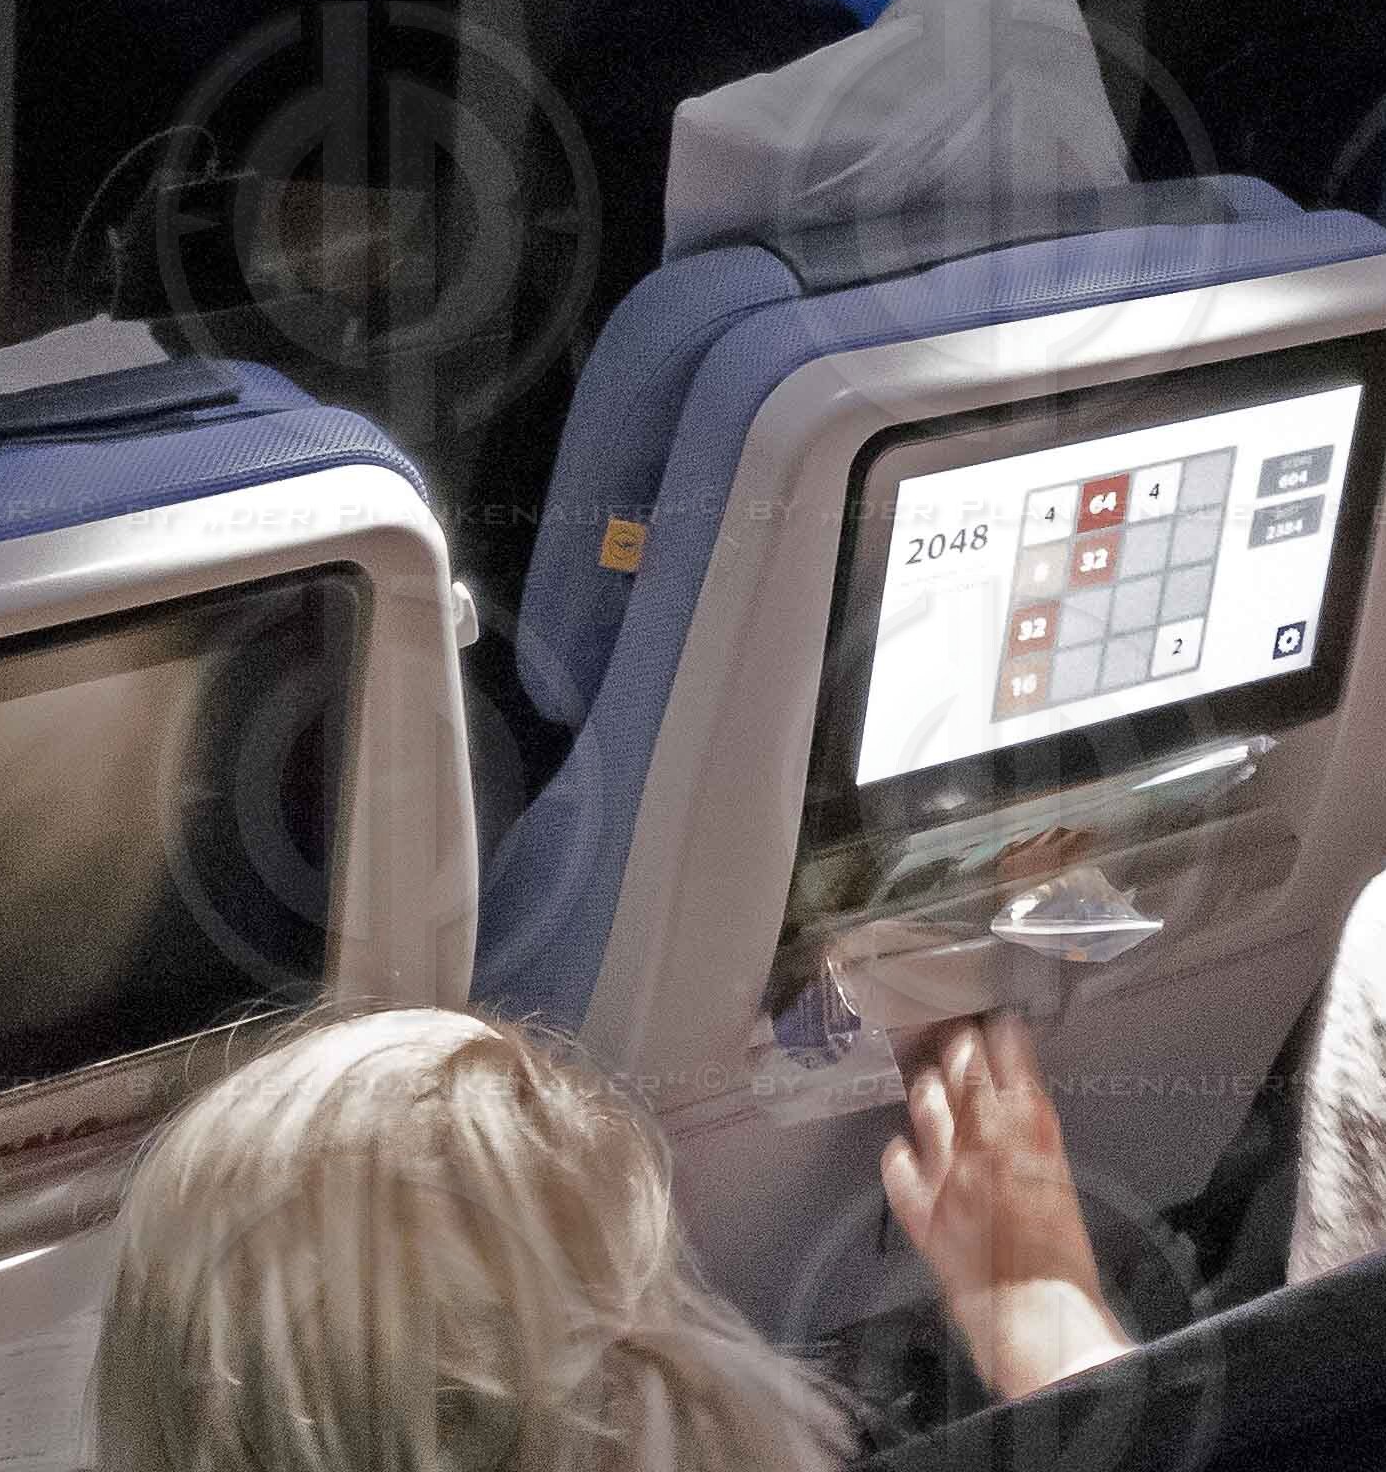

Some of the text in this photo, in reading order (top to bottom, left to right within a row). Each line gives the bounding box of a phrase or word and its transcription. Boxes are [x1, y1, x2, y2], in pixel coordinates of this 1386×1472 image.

[1089, 491, 1118, 515] 64
[1149, 483, 1160, 500] 4
[1045, 507, 1056, 524] 4
[905, 524, 989, 565] 2048
[1079, 548, 1108, 572] 32
[1018, 617, 1047, 641] 32
[1172, 638, 1183, 656] 2
[1011, 673, 1038, 696] 16
